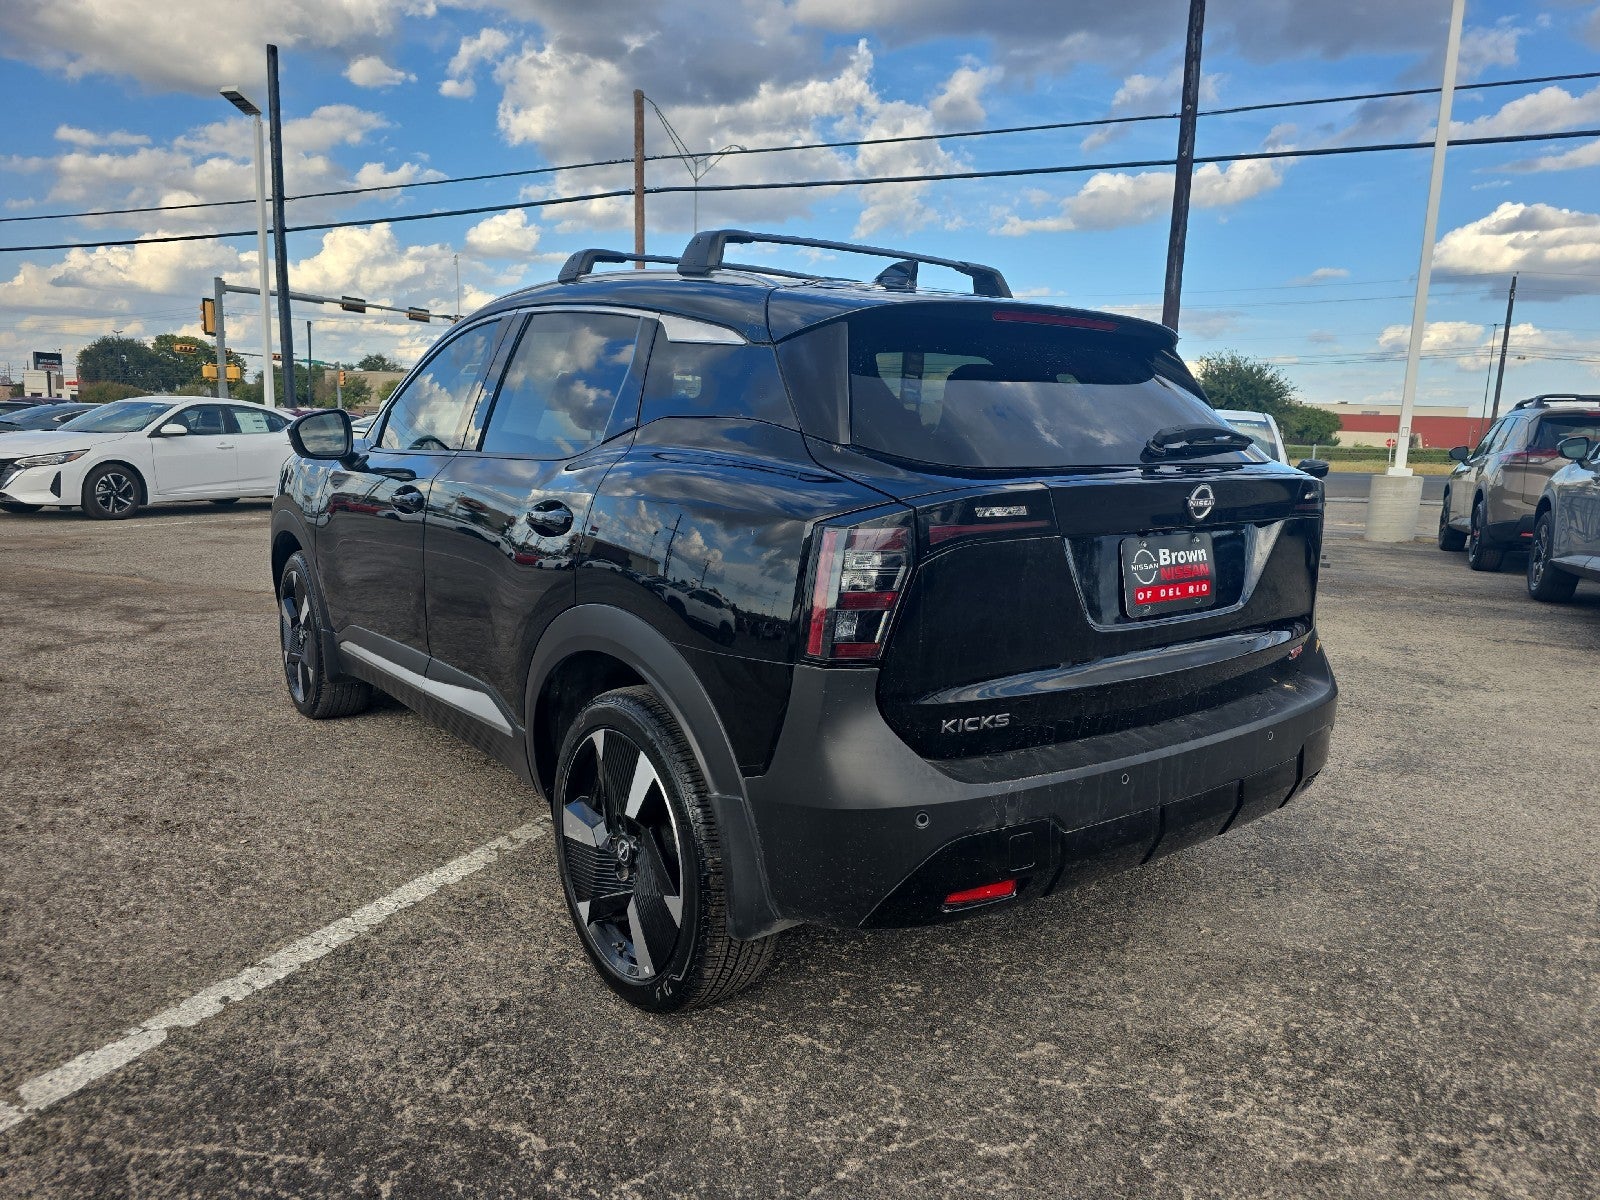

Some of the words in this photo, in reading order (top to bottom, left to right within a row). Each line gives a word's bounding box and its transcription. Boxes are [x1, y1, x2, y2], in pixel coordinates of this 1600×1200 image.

[1159, 548, 1207, 566] Brown
[1131, 563, 1159, 571] NISSAN
[1160, 563, 1209, 580] NISSAN
[1137, 590, 1152, 600] OF
[1160, 587, 1181, 597] DEL
[1188, 583, 1208, 594] RIO
[940, 713, 1010, 734] KICKS
